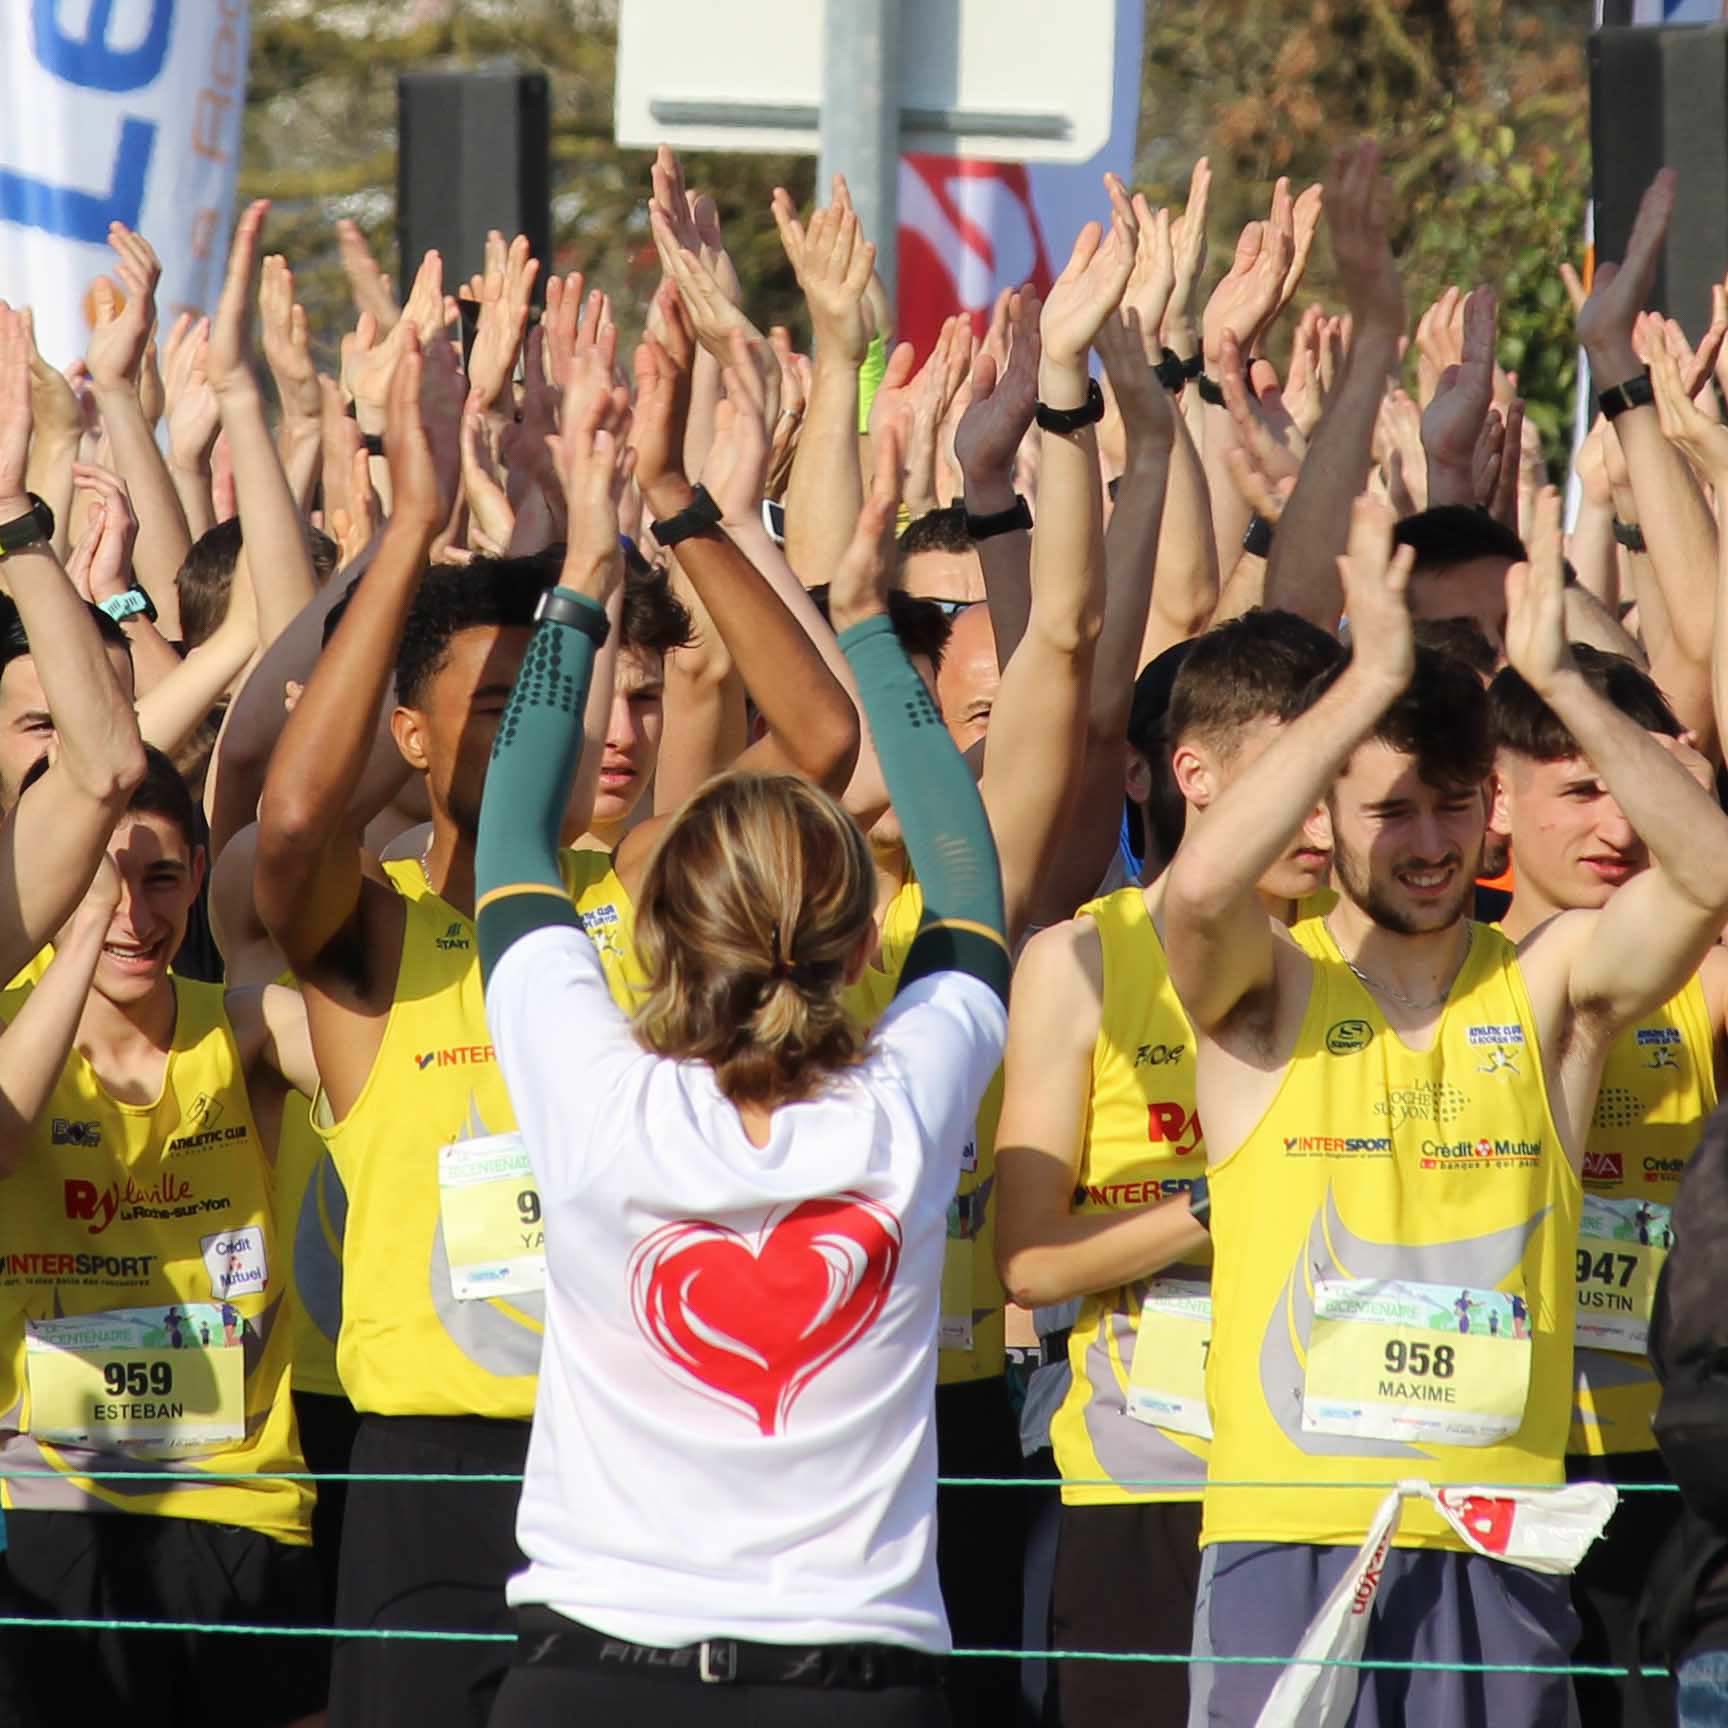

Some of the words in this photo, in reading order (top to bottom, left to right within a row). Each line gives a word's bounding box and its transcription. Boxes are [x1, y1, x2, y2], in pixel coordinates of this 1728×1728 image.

[1390, 1092, 1432, 1106] OCHE
[1299, 1136, 1392, 1153] INTERSPORT
[6, 1253, 154, 1278] INTERSPORT
[1575, 1248, 1638, 1289] 947
[1384, 1339, 1455, 1380] 958
[103, 1360, 173, 1397] 959
[1377, 1380, 1456, 1404] MAXIME
[93, 1402, 184, 1421] ESTEBAN
